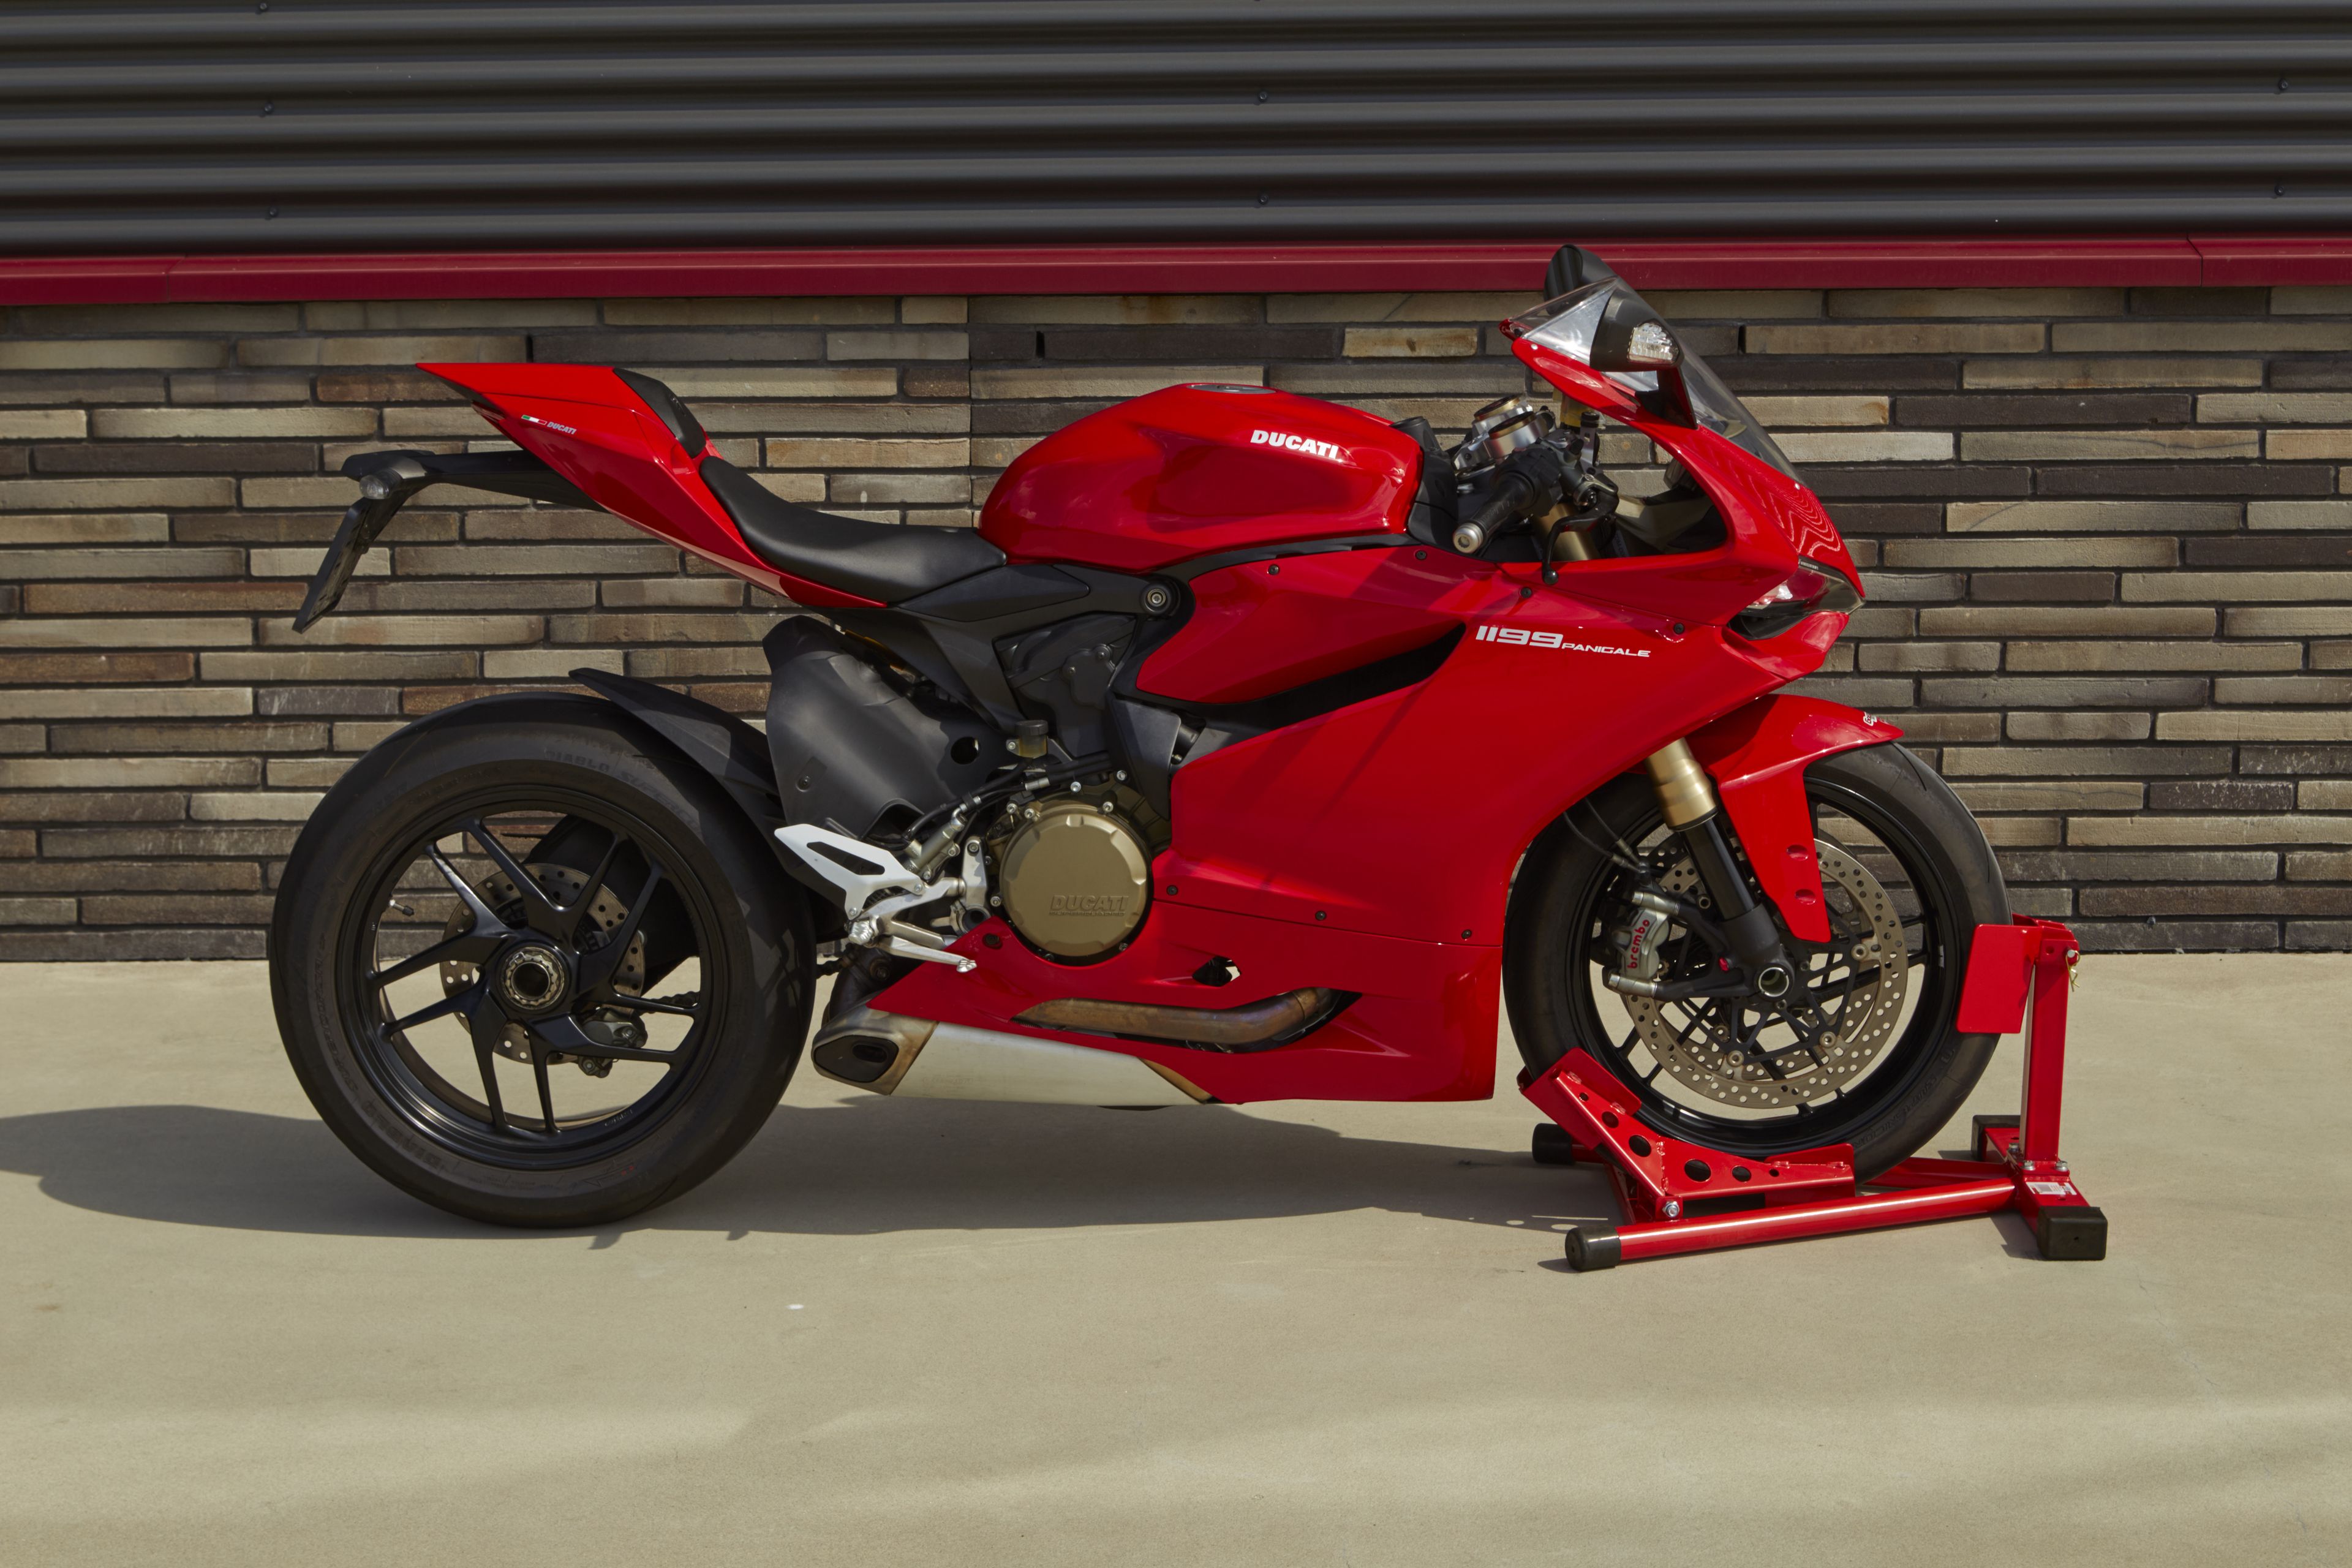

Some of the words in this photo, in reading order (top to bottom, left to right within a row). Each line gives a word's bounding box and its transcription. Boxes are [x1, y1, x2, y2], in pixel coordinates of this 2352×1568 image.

[547, 421, 577, 435] DUCATI
[1250, 429, 1339, 460] DUCATI
[1476, 625, 1564, 649] 1199
[1562, 643, 1651, 658] PANIGALE
[1050, 895, 1129, 911] DUCATI
[1627, 919, 1650, 970] brembo
